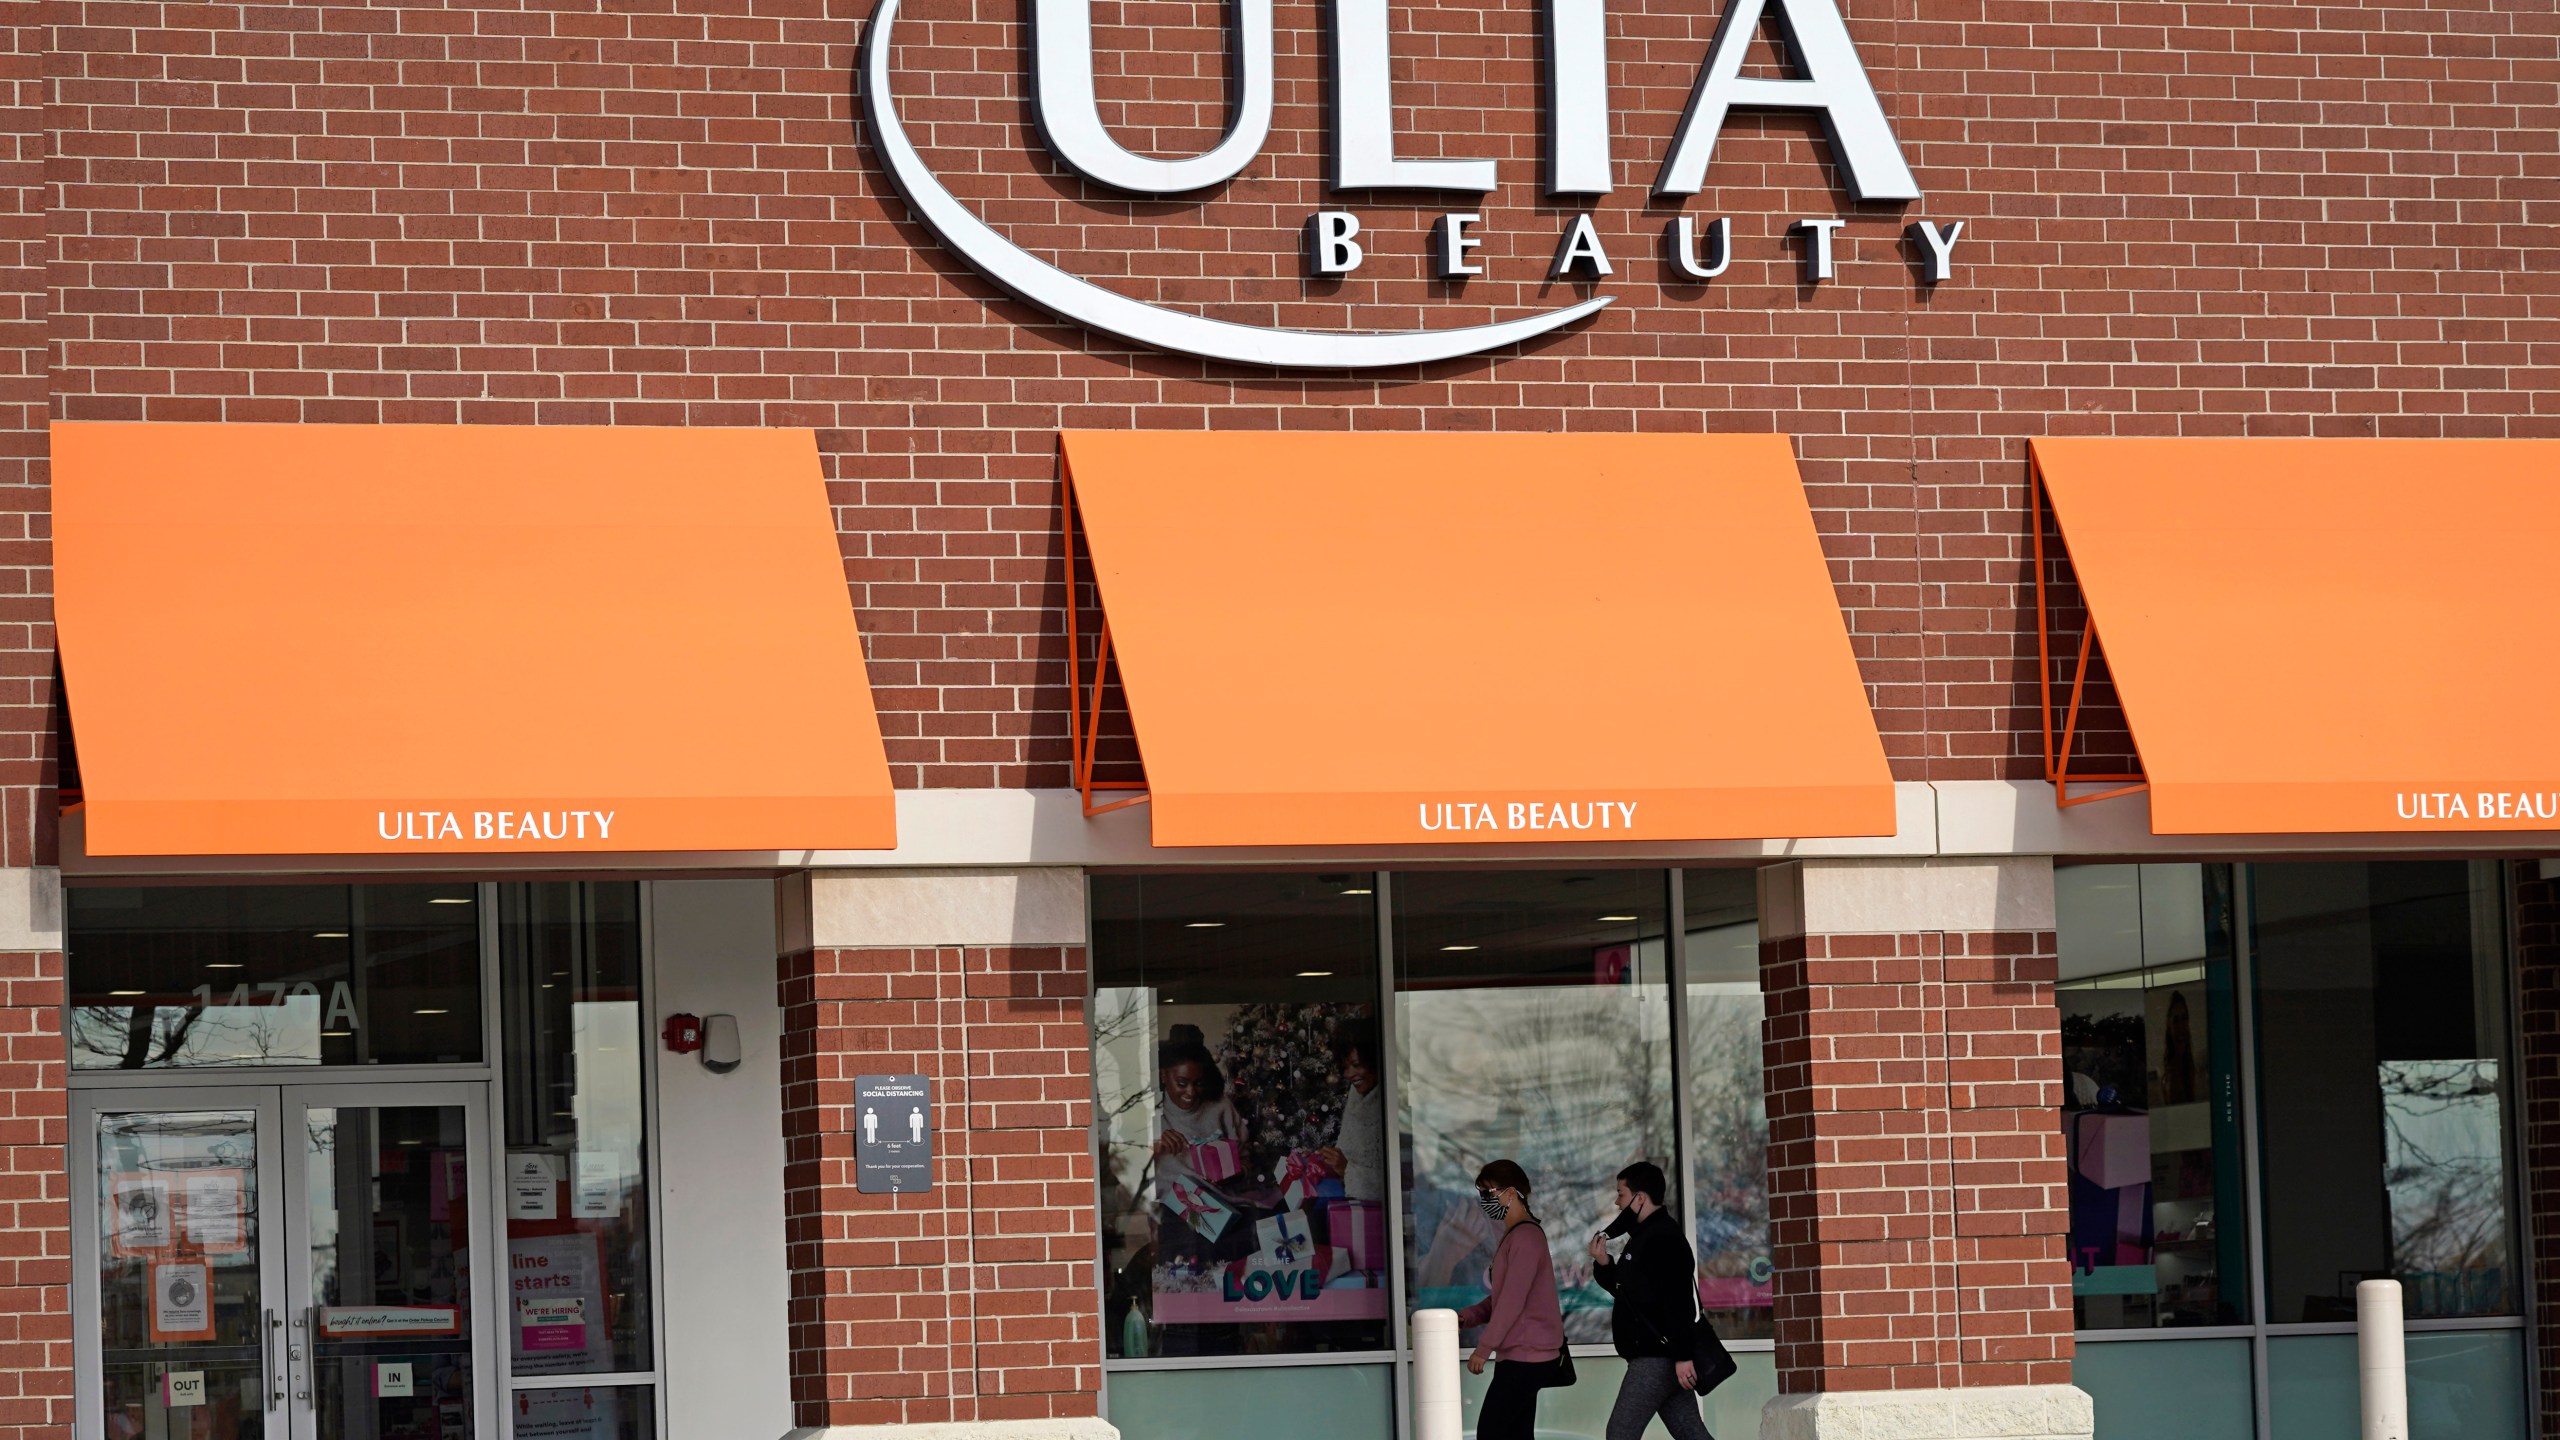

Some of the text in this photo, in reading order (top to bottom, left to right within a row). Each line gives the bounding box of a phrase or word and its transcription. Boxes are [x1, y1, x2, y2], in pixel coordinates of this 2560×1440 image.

[1311, 211, 1964, 284] BEAUTY
[2397, 793, 2560, 819] ULTA BEAU
[1420, 802, 1637, 830] ULTA BEAUTY
[378, 811, 615, 839] ULTA BEAUTY
[512, 1253, 549, 1269] line
[515, 1273, 571, 1290] starts
[1223, 1270, 1322, 1302] LOVE
[526, 1307, 579, 1316] WE'RE HIRING
[330, 1316, 356, 1329] bought
[362, 1315, 387, 1326] online?
[388, 1372, 401, 1382] IN
[174, 1380, 200, 1391] OUT
[555, 1427, 579, 1435] yourself
